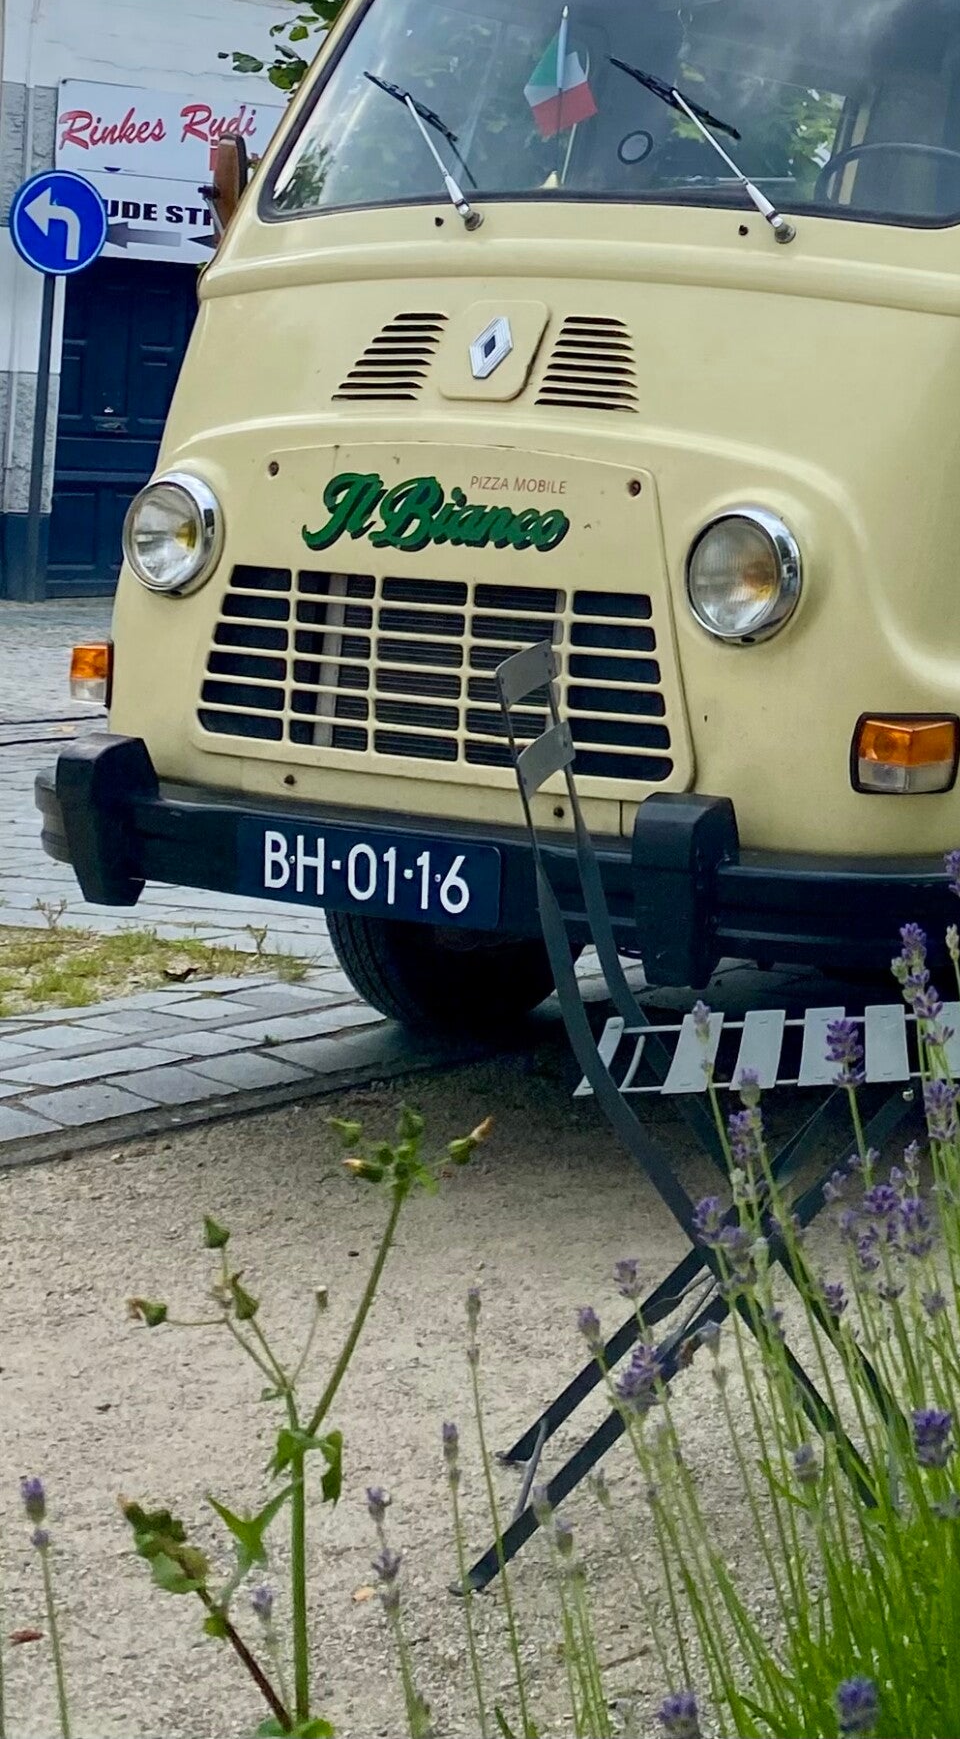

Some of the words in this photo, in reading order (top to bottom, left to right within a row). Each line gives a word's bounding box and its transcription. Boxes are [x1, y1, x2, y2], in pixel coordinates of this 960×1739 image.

[58, 107, 166, 151] Rinkes
[180, 104, 257, 142] Rudi
[104, 198, 157, 221] UDE
[470, 475, 509, 491] PIZZA
[513, 477, 567, 495] MOBILE
[368, 476, 570, 552] Bianco
[264, 830, 470, 914] BH-01-16
